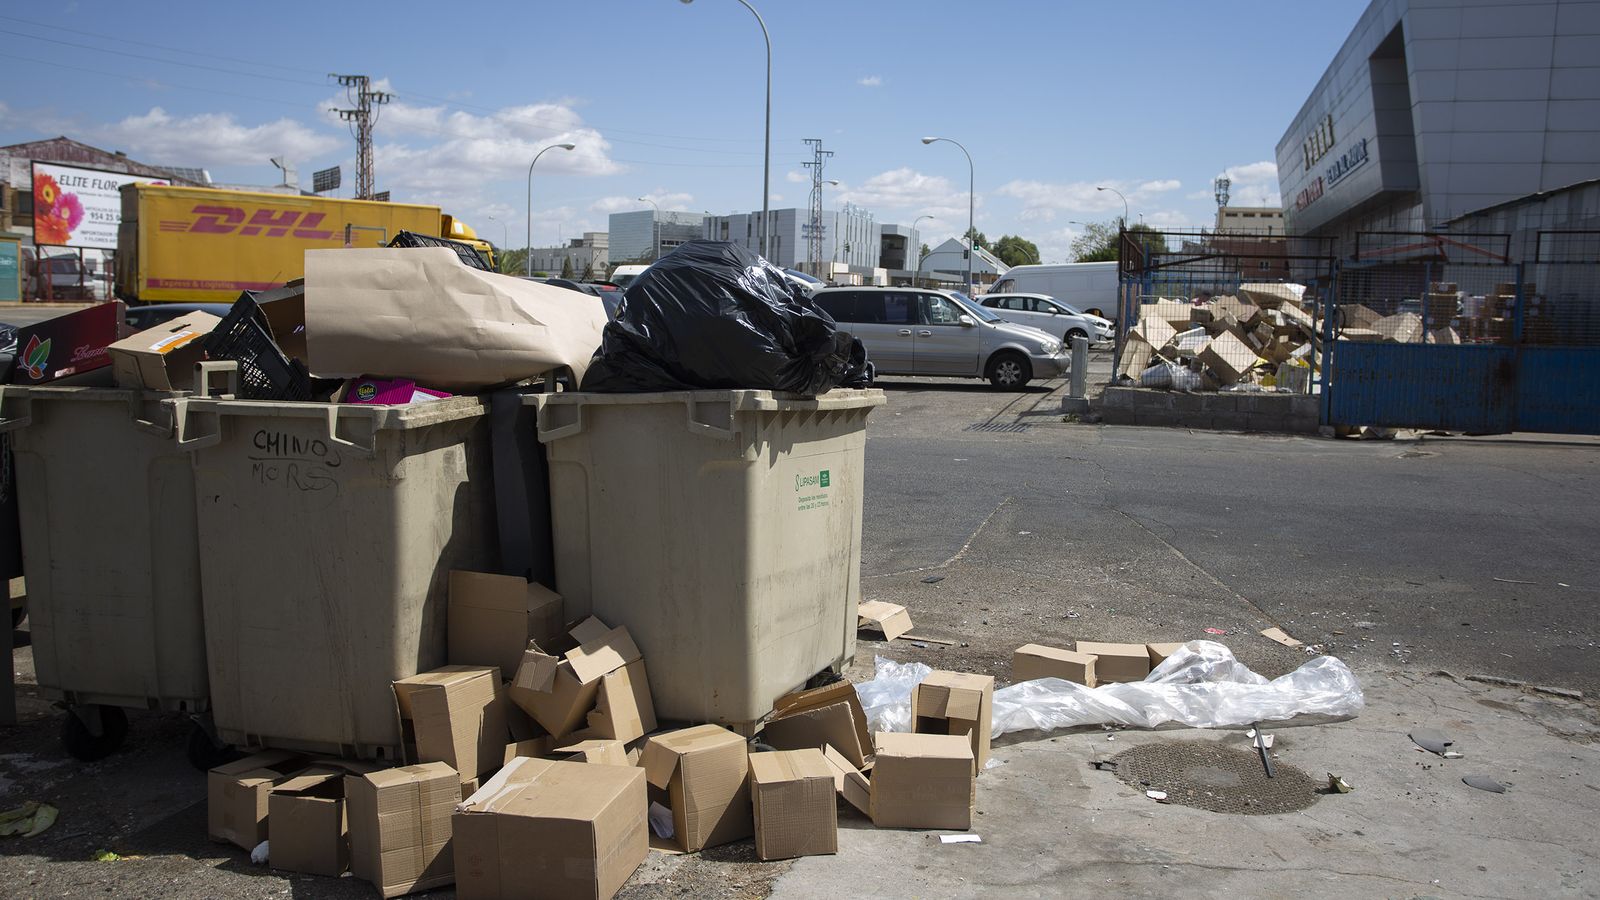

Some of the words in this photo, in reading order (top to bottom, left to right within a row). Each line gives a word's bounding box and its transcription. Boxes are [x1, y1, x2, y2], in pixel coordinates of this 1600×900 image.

[59, 174, 89, 188] ELITE
[92, 178, 118, 191] FLOR
[90, 212, 104, 220] 954
[105, 213, 114, 221] 25
[188, 205, 334, 239] DHL
[160, 280, 191, 289] Express
[200, 280, 234, 290] Logistics
[253, 429, 342, 467] CHINOS
